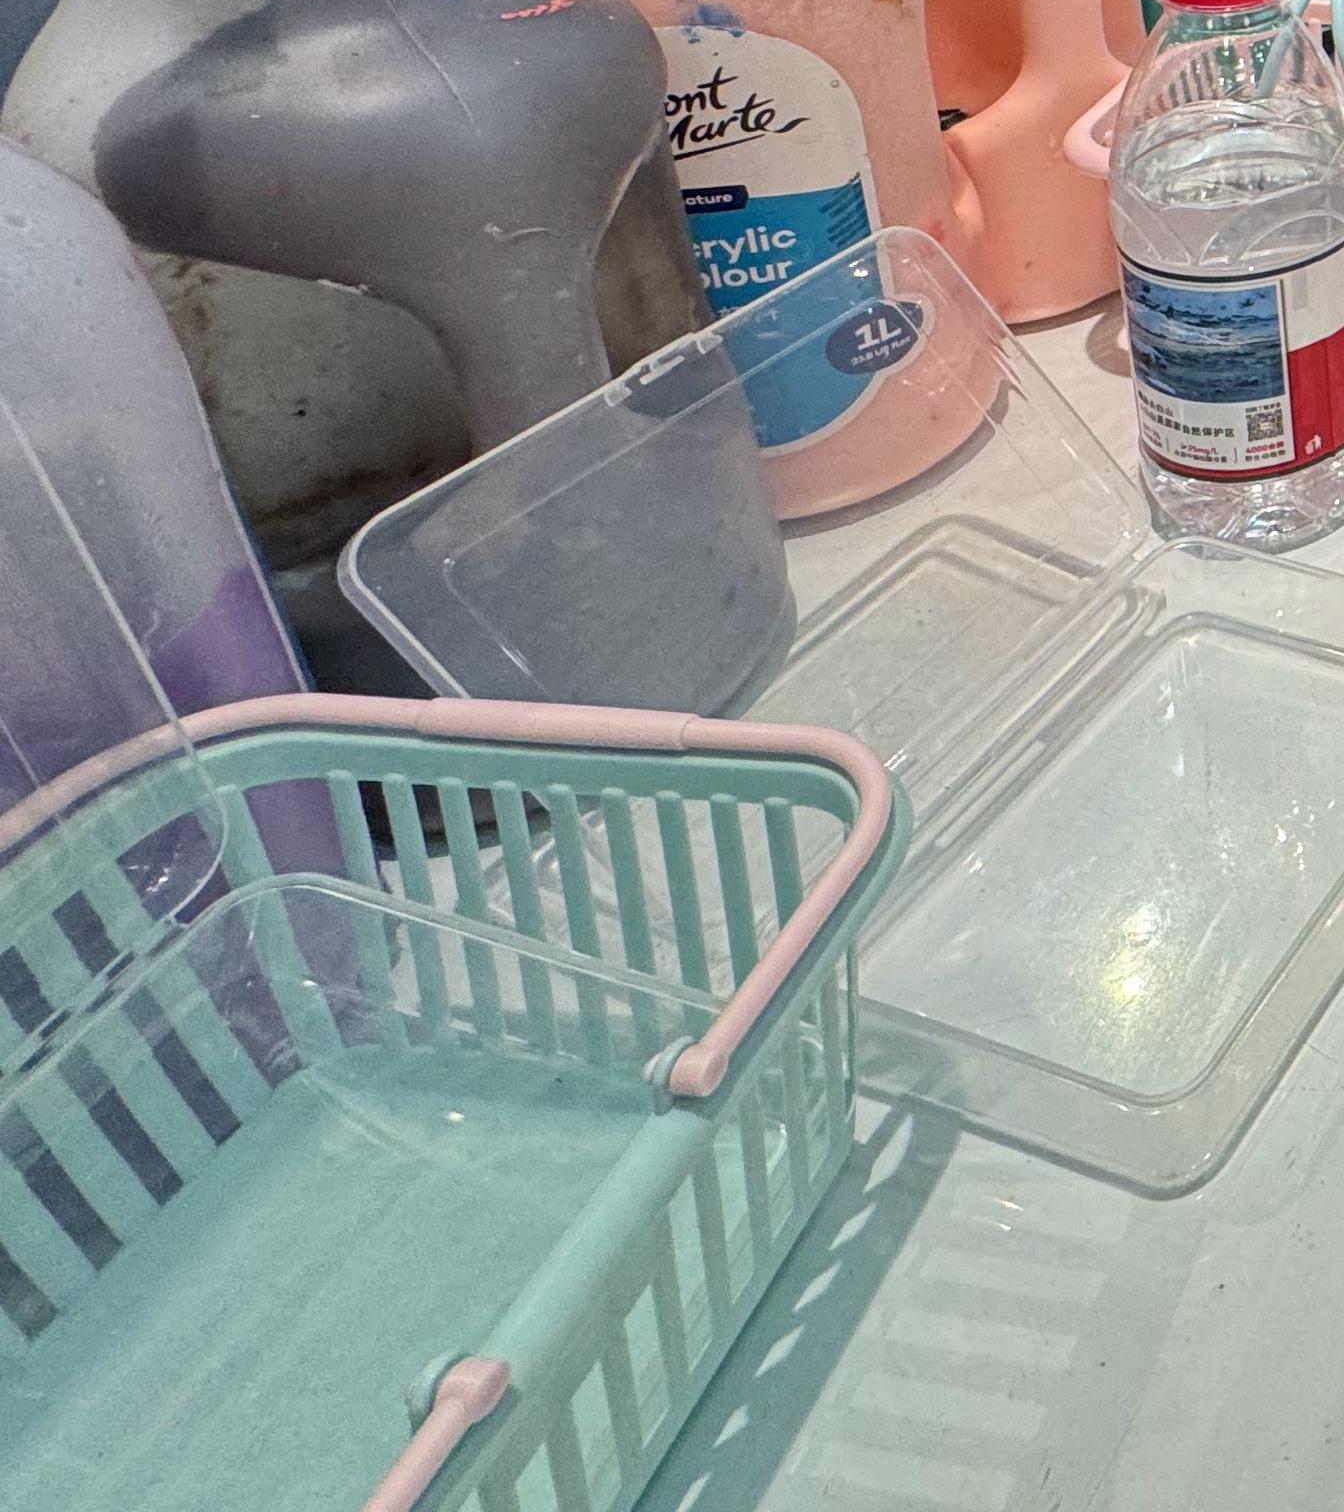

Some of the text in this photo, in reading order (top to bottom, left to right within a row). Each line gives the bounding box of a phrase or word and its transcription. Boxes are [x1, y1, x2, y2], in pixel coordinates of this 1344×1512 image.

[664, 65, 738, 117] ont
[685, 191, 734, 206] ature
[854, 317, 902, 351] 1L
